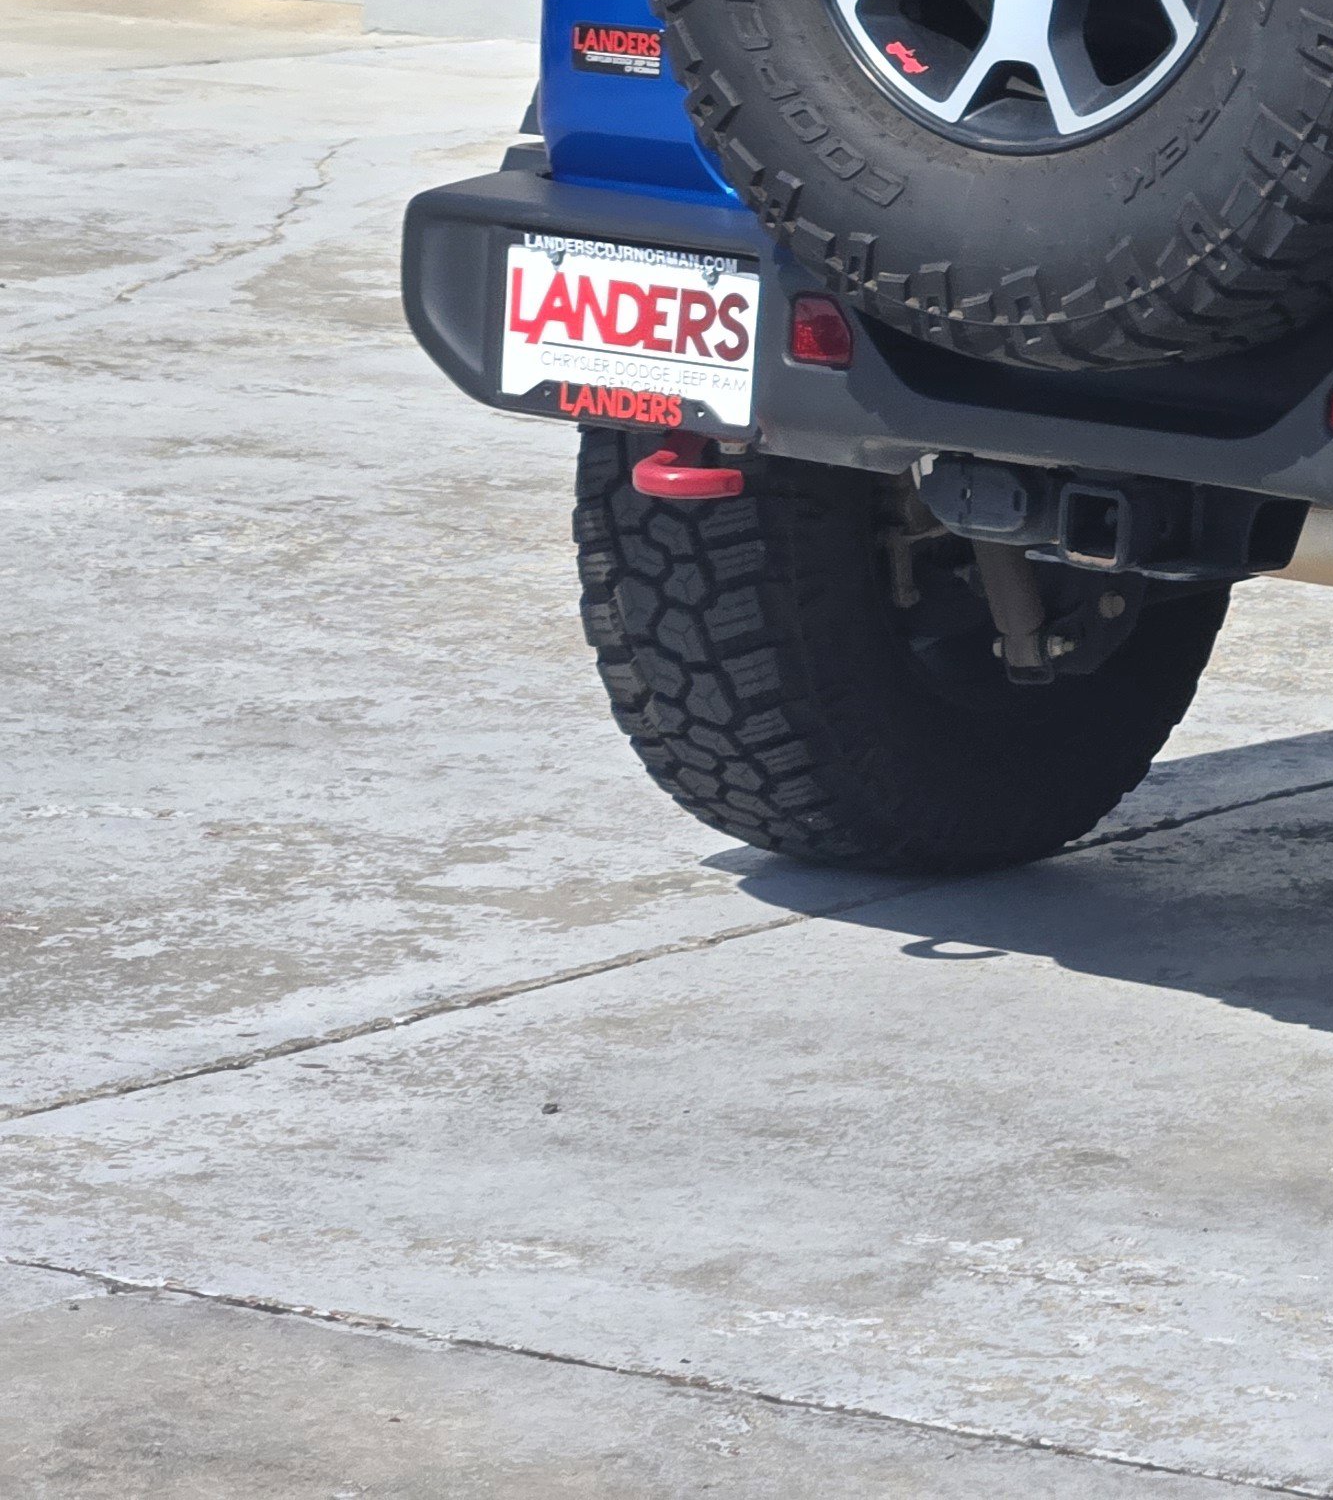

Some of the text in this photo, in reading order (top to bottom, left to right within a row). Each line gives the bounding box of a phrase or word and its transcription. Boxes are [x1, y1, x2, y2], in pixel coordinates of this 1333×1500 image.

[573, 26, 661, 57] LANDERS
[524, 233, 738, 274] LANDERSCDJRNORMAN.COM
[509, 266, 750, 362] LANDERS
[540, 350, 748, 393] CHRYSLER DODGE JEEP RAM
[559, 381, 683, 428] LANDERS
